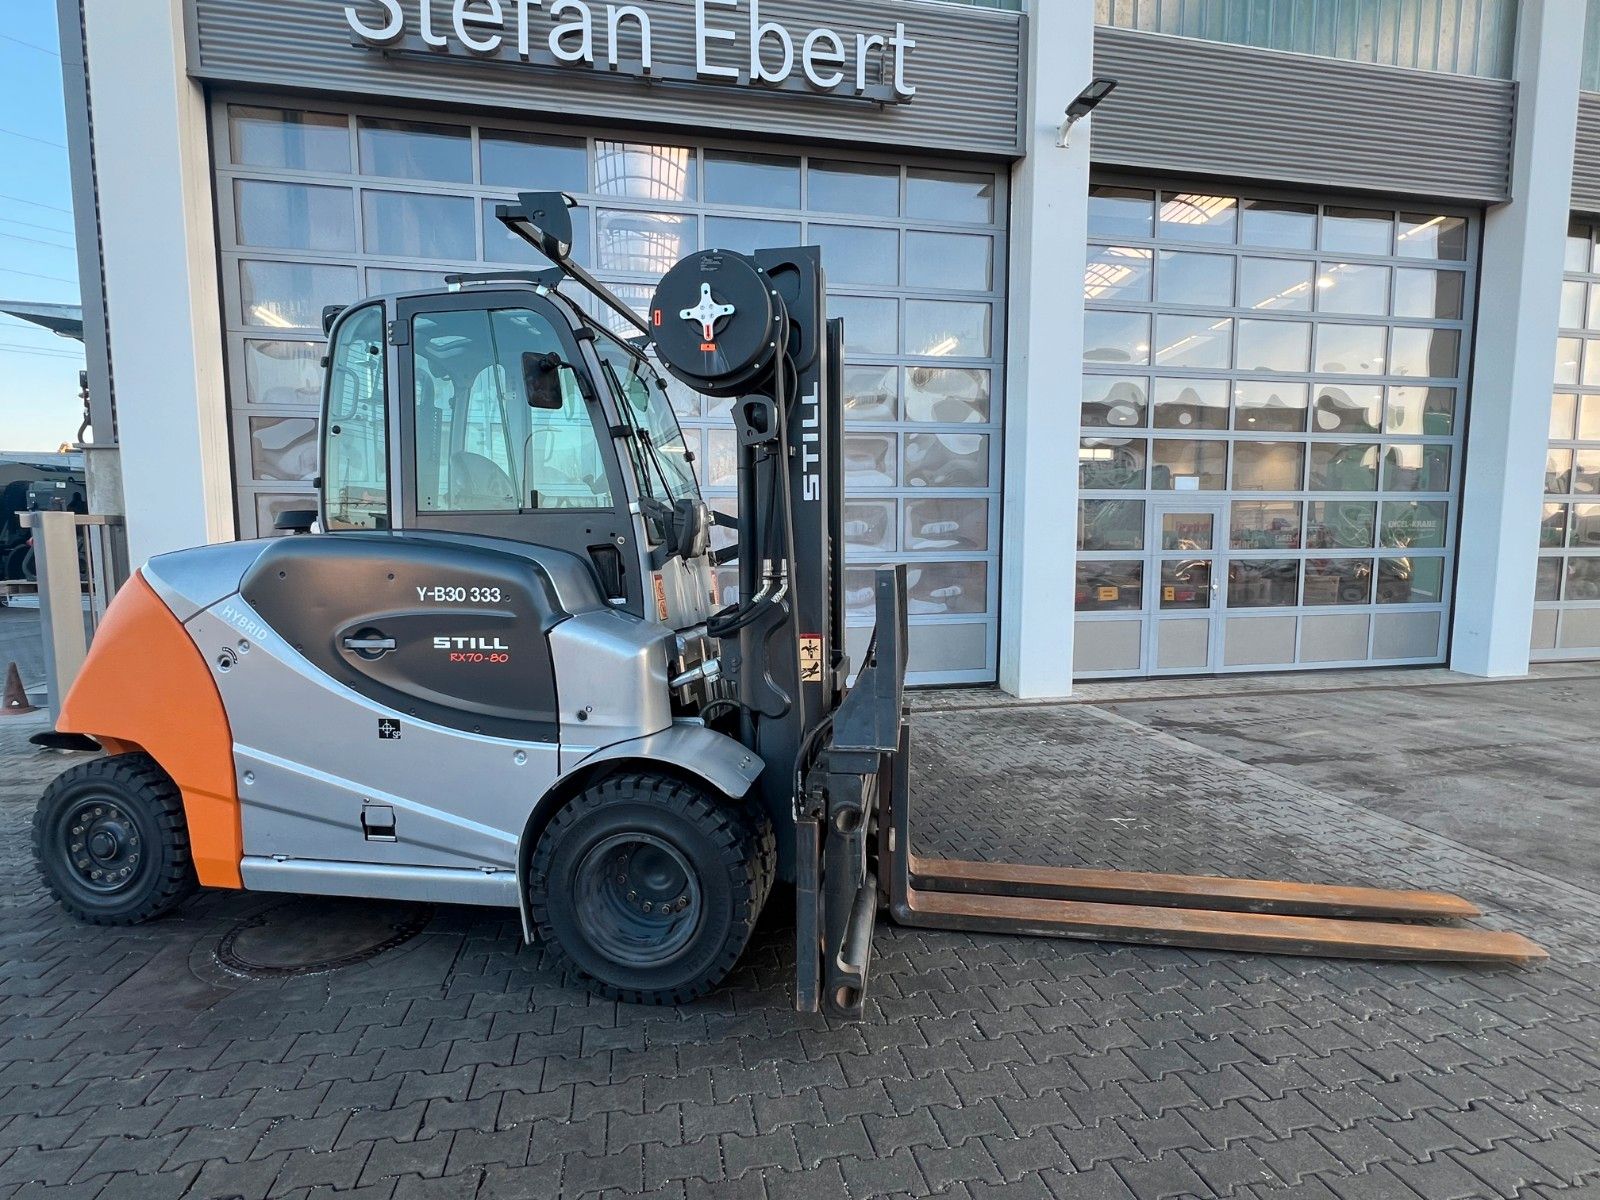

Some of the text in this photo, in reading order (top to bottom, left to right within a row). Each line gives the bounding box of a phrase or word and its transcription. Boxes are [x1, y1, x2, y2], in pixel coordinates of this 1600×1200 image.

[344, 0, 916, 95] Stefan Ebert
[802, 381, 820, 501] STILL
[416, 586, 501, 603] Y-B30 333
[222, 605, 268, 640] HYBRID
[433, 636, 509, 650] STILL
[449, 652, 509, 663] RX70-80
